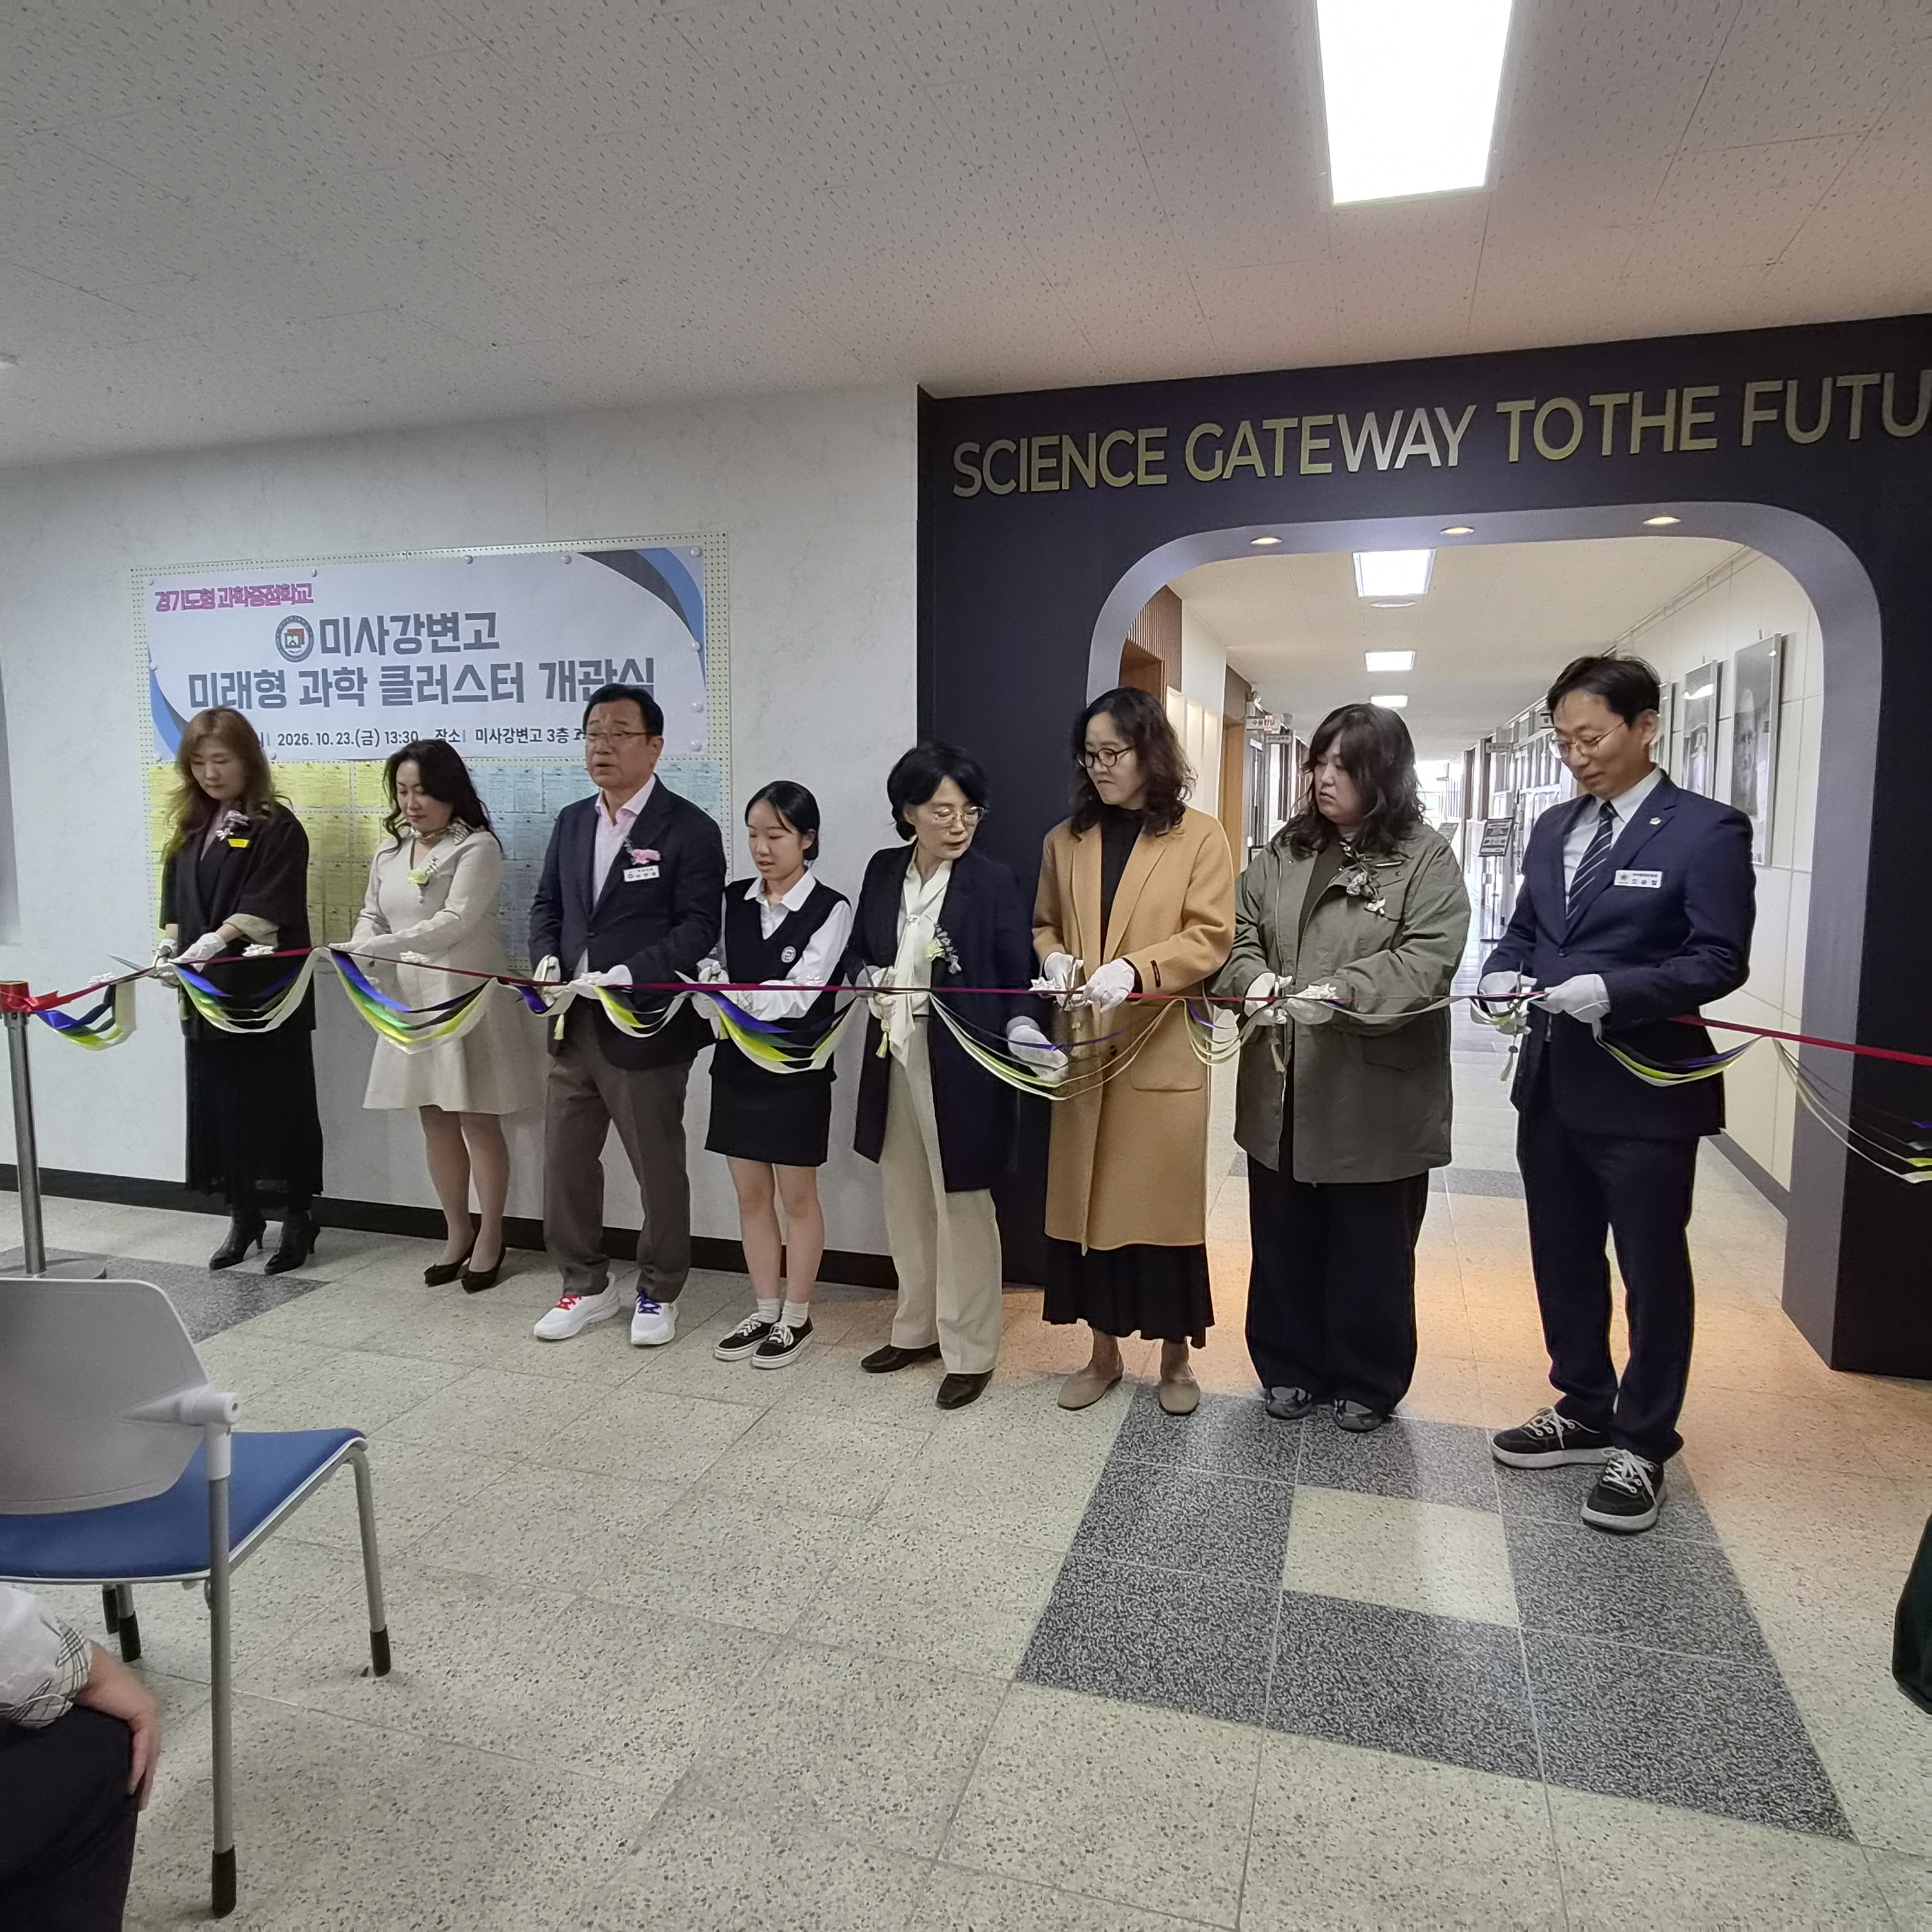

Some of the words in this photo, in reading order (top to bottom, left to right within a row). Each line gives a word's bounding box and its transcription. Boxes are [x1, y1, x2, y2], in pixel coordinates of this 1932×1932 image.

[953, 427, 1167, 497] SCIENCE
[1185, 405, 1477, 482] GATEWAY
[1742, 369, 1932, 446] FUTU
[154, 588, 216, 612] 경기도형
[217, 583, 314, 608] 과학중점학교
[319, 611, 500, 657] 미사강변고
[188, 669, 287, 710] 미래형
[298, 666, 368, 708] 과학
[378, 662, 525, 706] 클러스터
[384, 731, 419, 745] 13:30
[475, 727, 543, 745] 미사강변고
[546, 727, 570, 744] 3층
